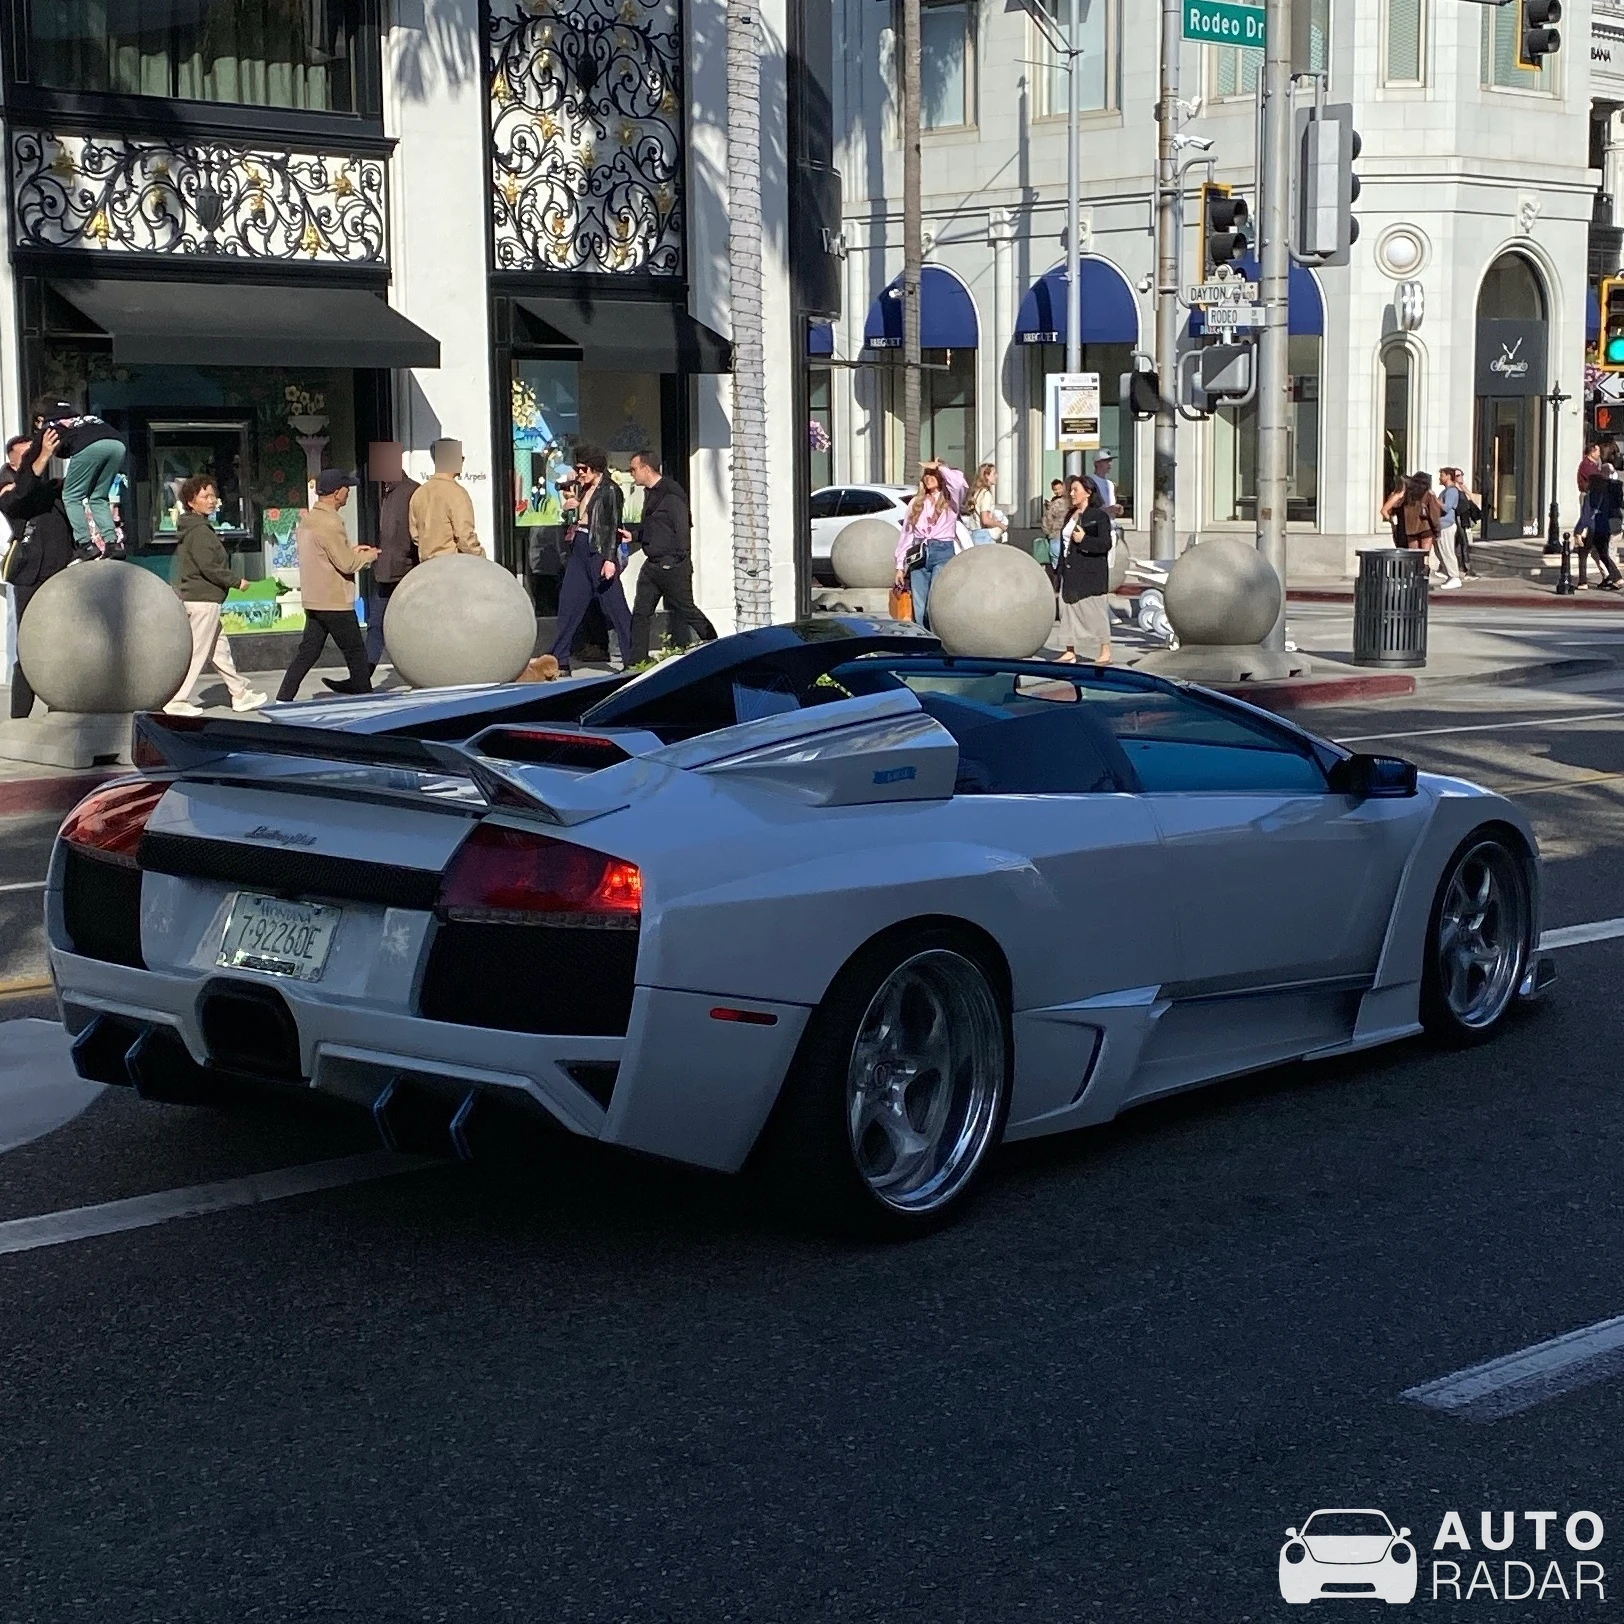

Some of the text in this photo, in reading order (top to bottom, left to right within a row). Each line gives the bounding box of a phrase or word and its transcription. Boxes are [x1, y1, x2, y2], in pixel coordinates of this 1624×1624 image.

[1190, 8, 1264, 39] Rodeo Dr
[1191, 287, 1227, 301] DAYTON
[1211, 310, 1238, 323] RODEO
[1023, 332, 1059, 342] BREGUET
[464, 471, 487, 483] Arpels
